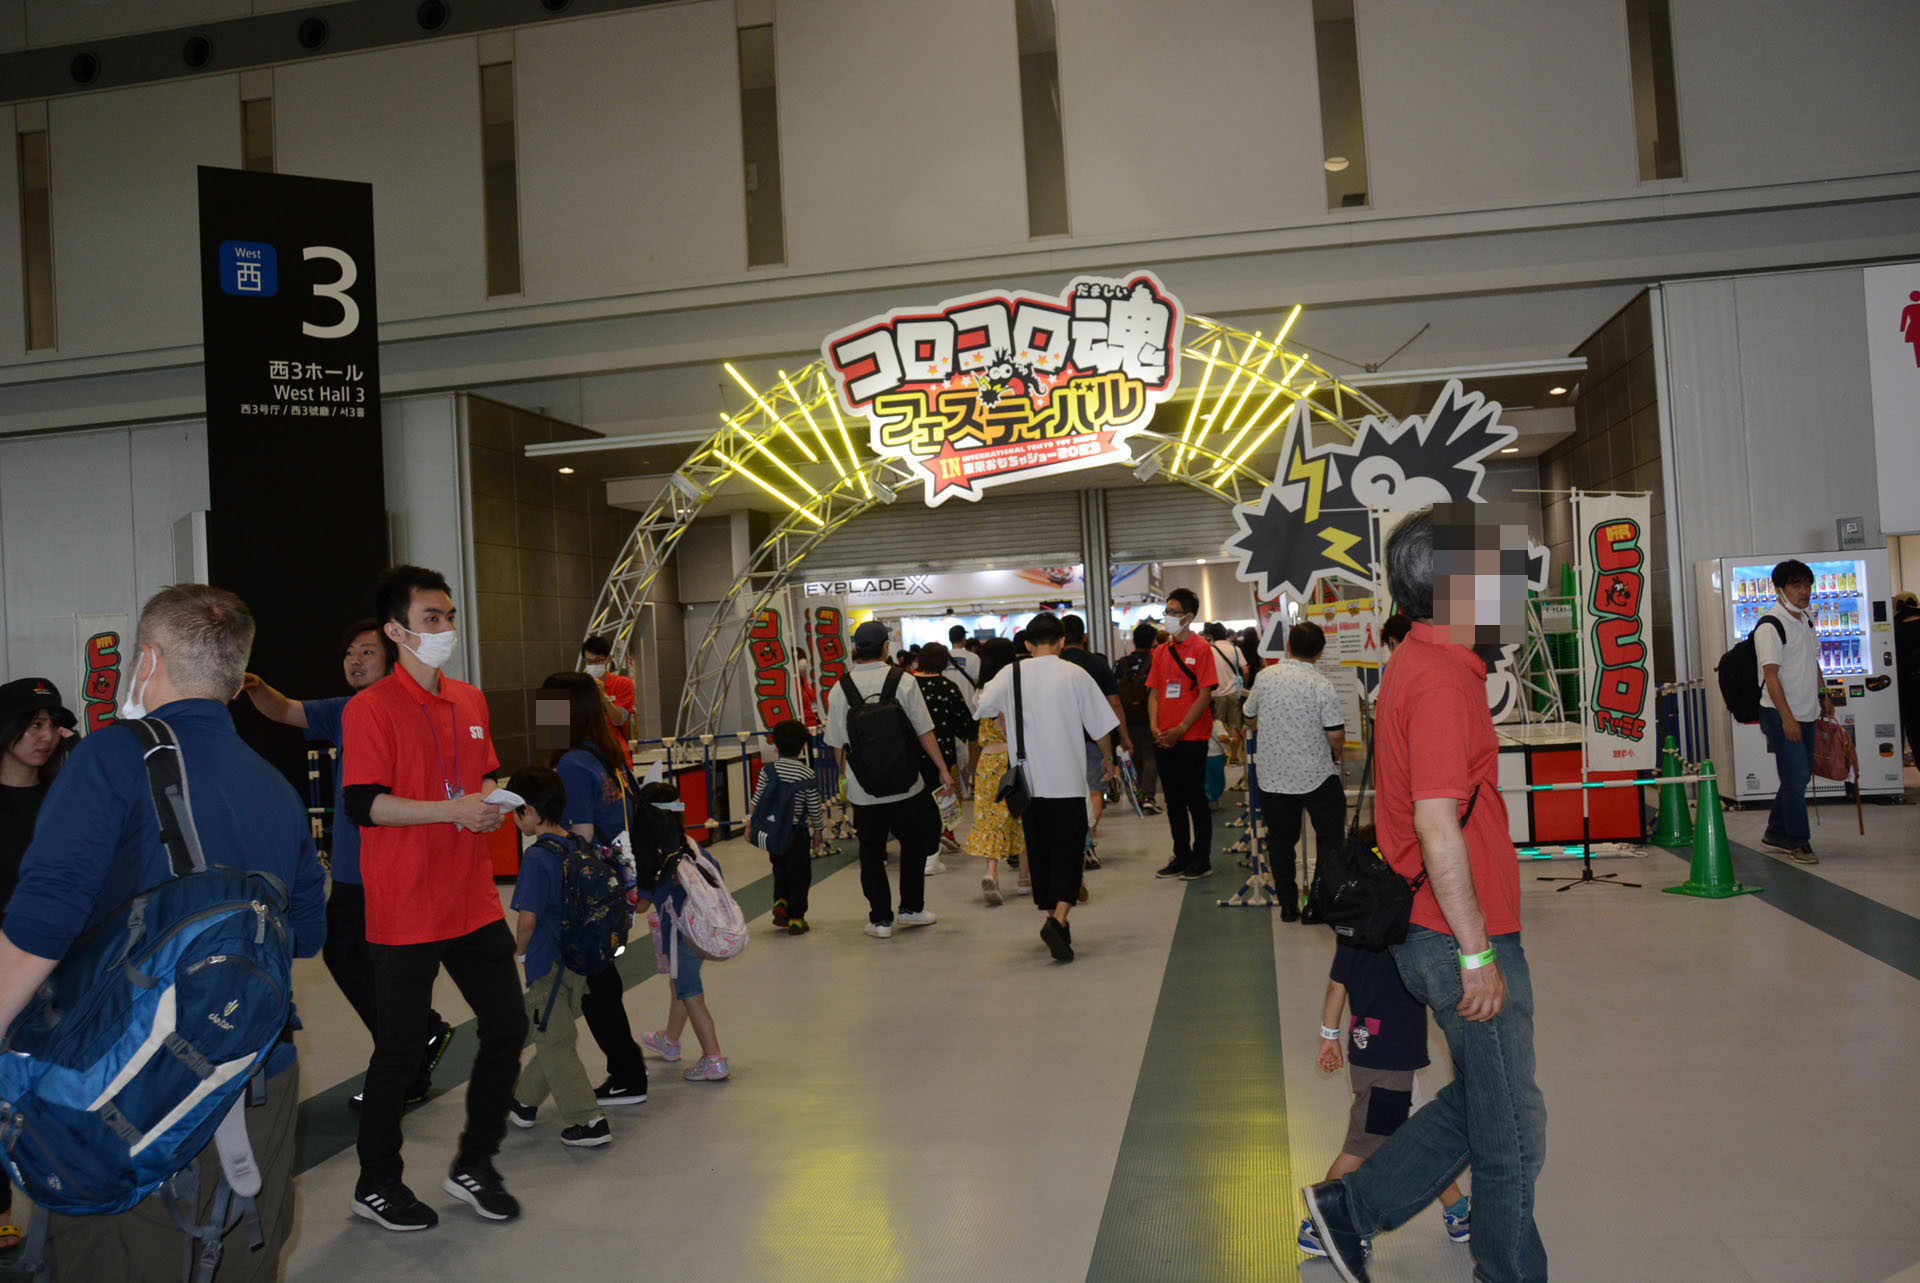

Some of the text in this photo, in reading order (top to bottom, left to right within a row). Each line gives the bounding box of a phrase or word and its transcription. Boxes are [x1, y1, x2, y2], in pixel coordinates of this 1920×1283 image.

[235, 247, 261, 259] West
[236, 262, 261, 291] 西
[302, 246, 360, 339] 3
[1076, 284, 1128, 298] だましい
[834, 285, 1172, 402] コロコロ魂
[269, 360, 363, 381] 西3ホール
[274, 385, 365, 402] West Hall 3
[241, 404, 280, 416] 西3号厅
[876, 372, 1146, 455] フェスティバル
[962, 434, 1098, 462] INTERNATIONAL TOKYO TOY SHOW
[940, 457, 962, 481] IN
[815, 607, 847, 716] コロコ
